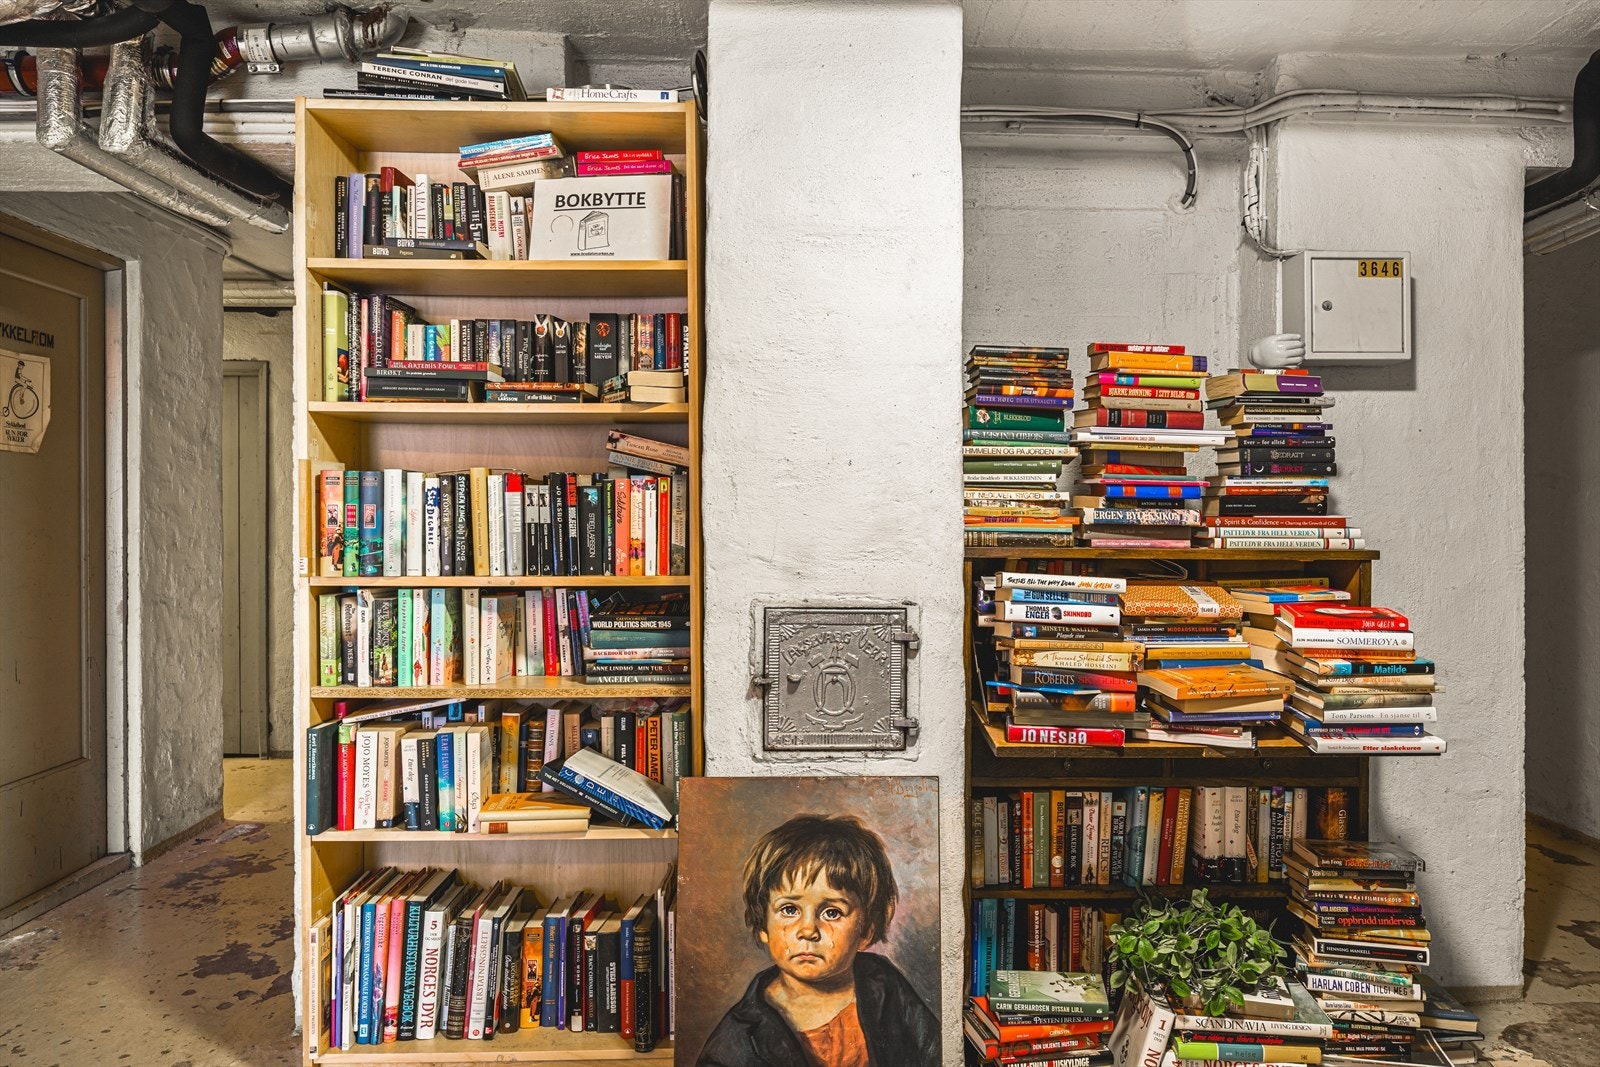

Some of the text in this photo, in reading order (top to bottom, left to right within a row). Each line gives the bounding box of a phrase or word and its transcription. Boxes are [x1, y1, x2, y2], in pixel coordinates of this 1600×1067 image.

[372, 66, 442, 80] TERENCE CONRAN
[582, 89, 637, 100] HomeCrafts
[493, 171, 516, 180] ALENE
[516, 167, 546, 177] SAMMEN
[416, 182, 426, 220] SARAH
[555, 192, 645, 208] BOKBYTTE
[488, 196, 497, 232] BALANSEKUNST
[1360, 261, 1399, 276] 3646
[615, 454, 664, 469] ANNIE PROULX
[427, 491, 436, 504] Six
[556, 486, 562, 496] JO
[616, 491, 627, 524] Solitaire
[1127, 511, 1181, 520] BYLEKSIKON
[1032, 591, 1107, 603] GUN SELLER LAURIE
[344, 604, 353, 636] Redbreast
[1362, 620, 1375, 628] JOHN
[1336, 637, 1398, 646] SOMMERØYA
[1052, 652, 1076, 661] Thousand
[1079, 653, 1104, 664] Splendid
[1374, 664, 1407, 674] Matilde
[1034, 673, 1075, 684] ROBERTS
[650, 720, 658, 749] PETER
[1021, 729, 1087, 744] JO NESBØ
[361, 735, 370, 755] JOJO
[362, 758, 370, 788] MOYES
[1057, 825, 1064, 834] PÅ
[1101, 838, 1109, 872] RELICS
[1338, 917, 1415, 926] oppbrudd underveis
[377, 913, 386, 948] Vegetariske
[402, 906, 419, 1023] KULTURHISTORISK VEGBOK
[475, 931, 488, 1001] ERSTATNINGSRETT
[361, 953, 369, 994] INTERNASJONALE
[424, 948, 438, 997] NORGES
[1312, 978, 1342, 990] HARLAN
[1345, 981, 1370, 993] COBEN
[1394, 986, 1408, 995] MEG
[420, 1003, 434, 1028] DYR
[1195, 1018, 1267, 1032] SCANDINAVIA
